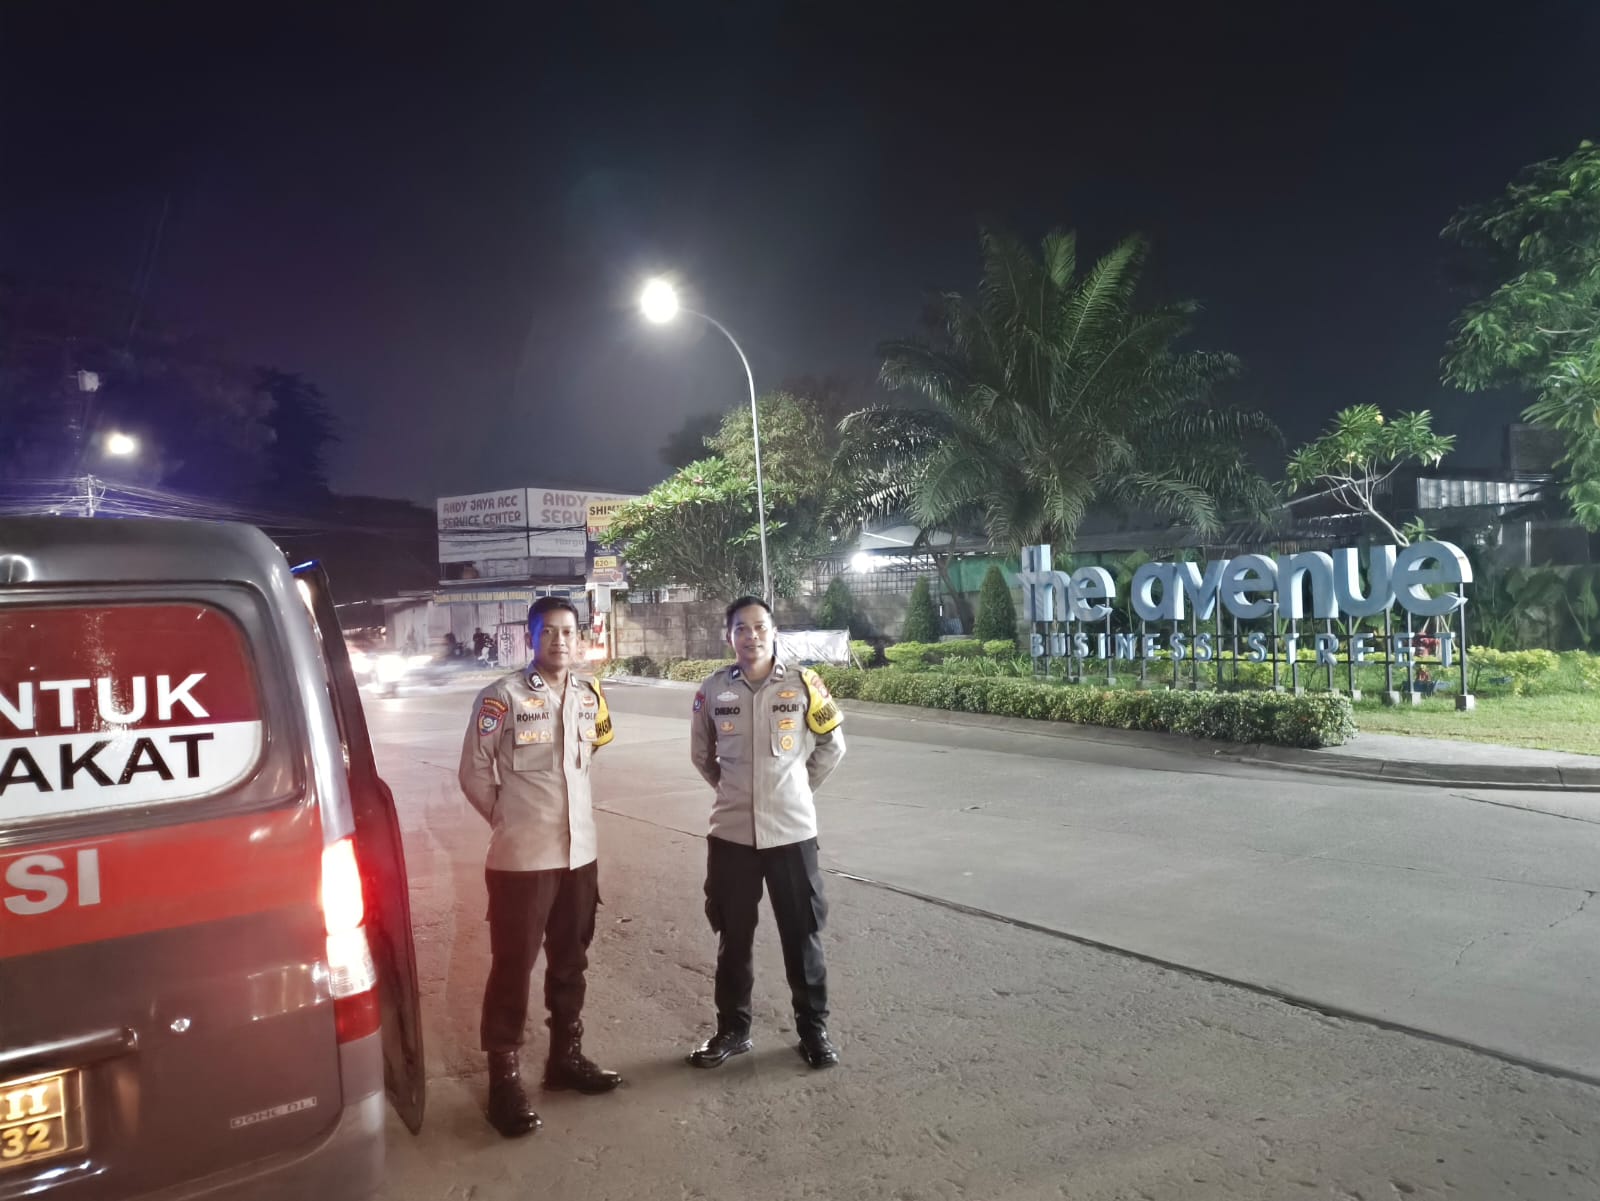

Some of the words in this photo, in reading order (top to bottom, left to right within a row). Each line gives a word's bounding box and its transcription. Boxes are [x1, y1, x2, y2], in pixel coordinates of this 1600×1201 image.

[443, 500, 468, 513] ANDY
[470, 497, 495, 511] JAYA
[498, 495, 518, 508] ACC
[543, 492, 588, 507] ANDY
[443, 514, 480, 529] SERVICE
[483, 510, 521, 525] CENTER
[1017, 543, 1117, 622] the
[1131, 540, 1473, 621] avenue
[1030, 632, 1213, 662] BUSINESS
[1248, 632, 1457, 668] STREET
[516, 711, 550, 722] ROHMAT
[772, 703, 799, 713] POLRI
[4, 848, 101, 915] SI
